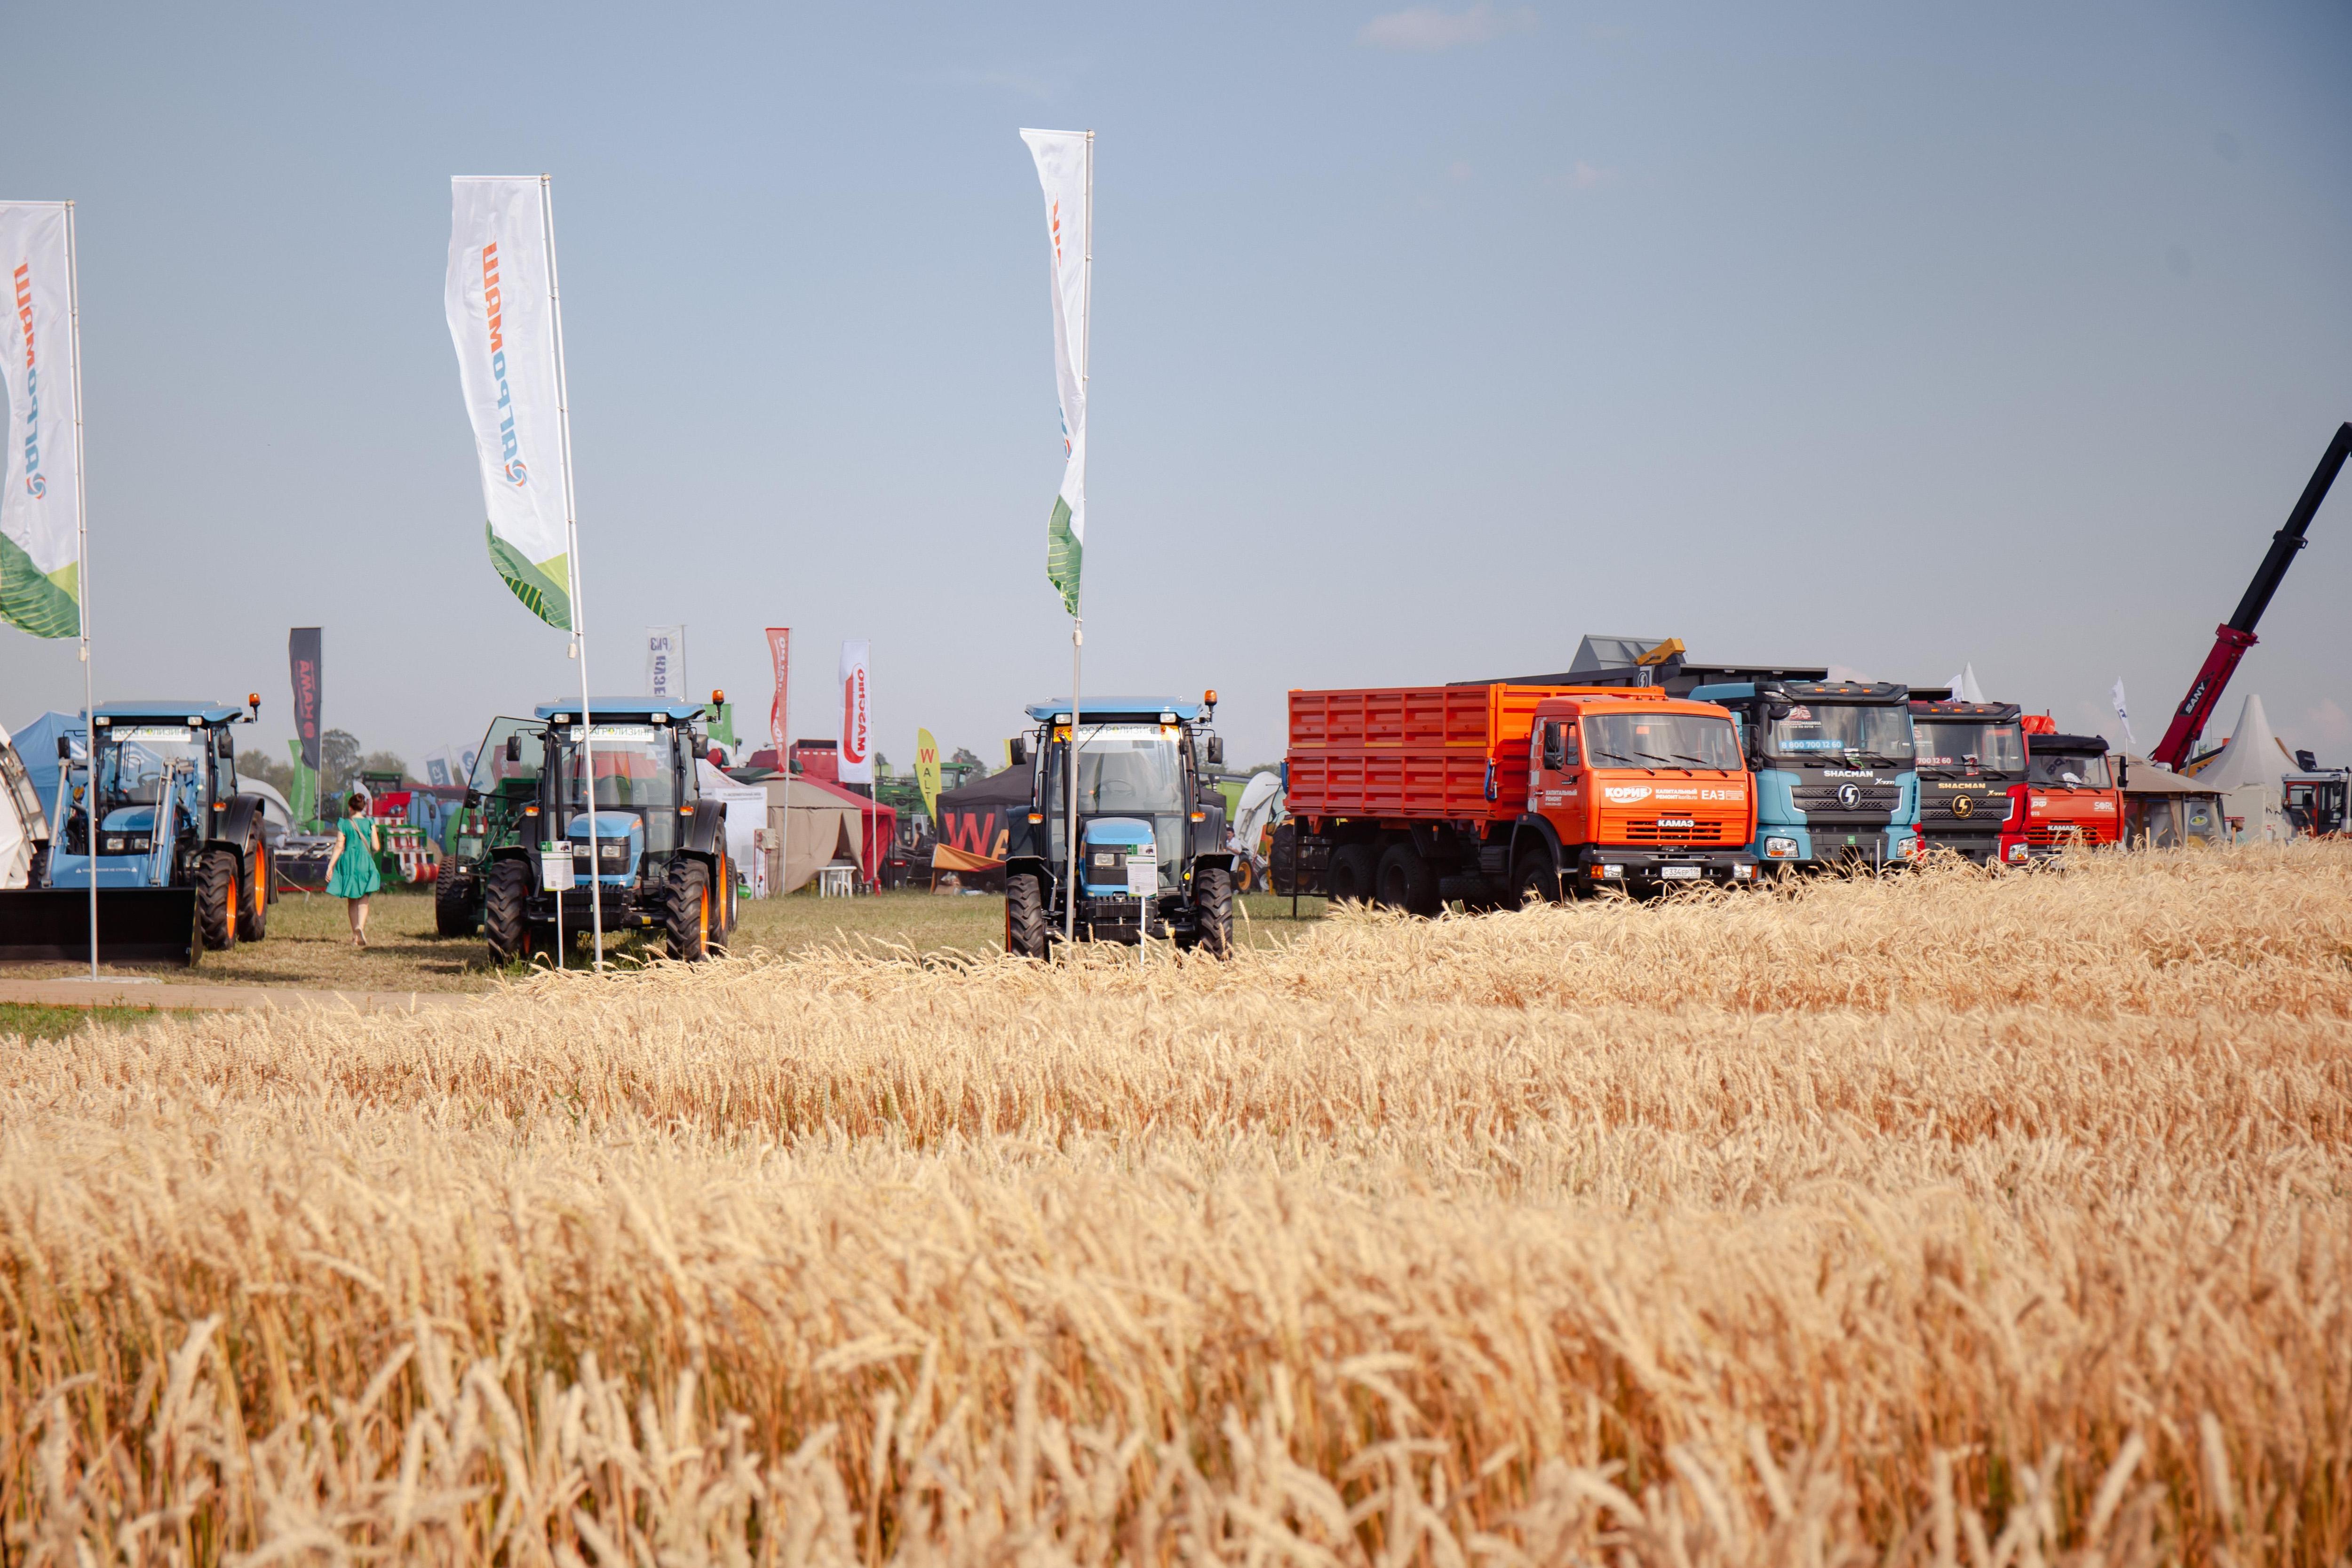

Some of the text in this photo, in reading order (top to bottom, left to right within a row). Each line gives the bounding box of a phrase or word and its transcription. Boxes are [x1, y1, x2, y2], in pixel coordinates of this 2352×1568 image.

[2185, 681, 2205, 714] SANY
[920, 748, 935, 799] WALT
[1605, 787, 1649, 798] КОРИБ
